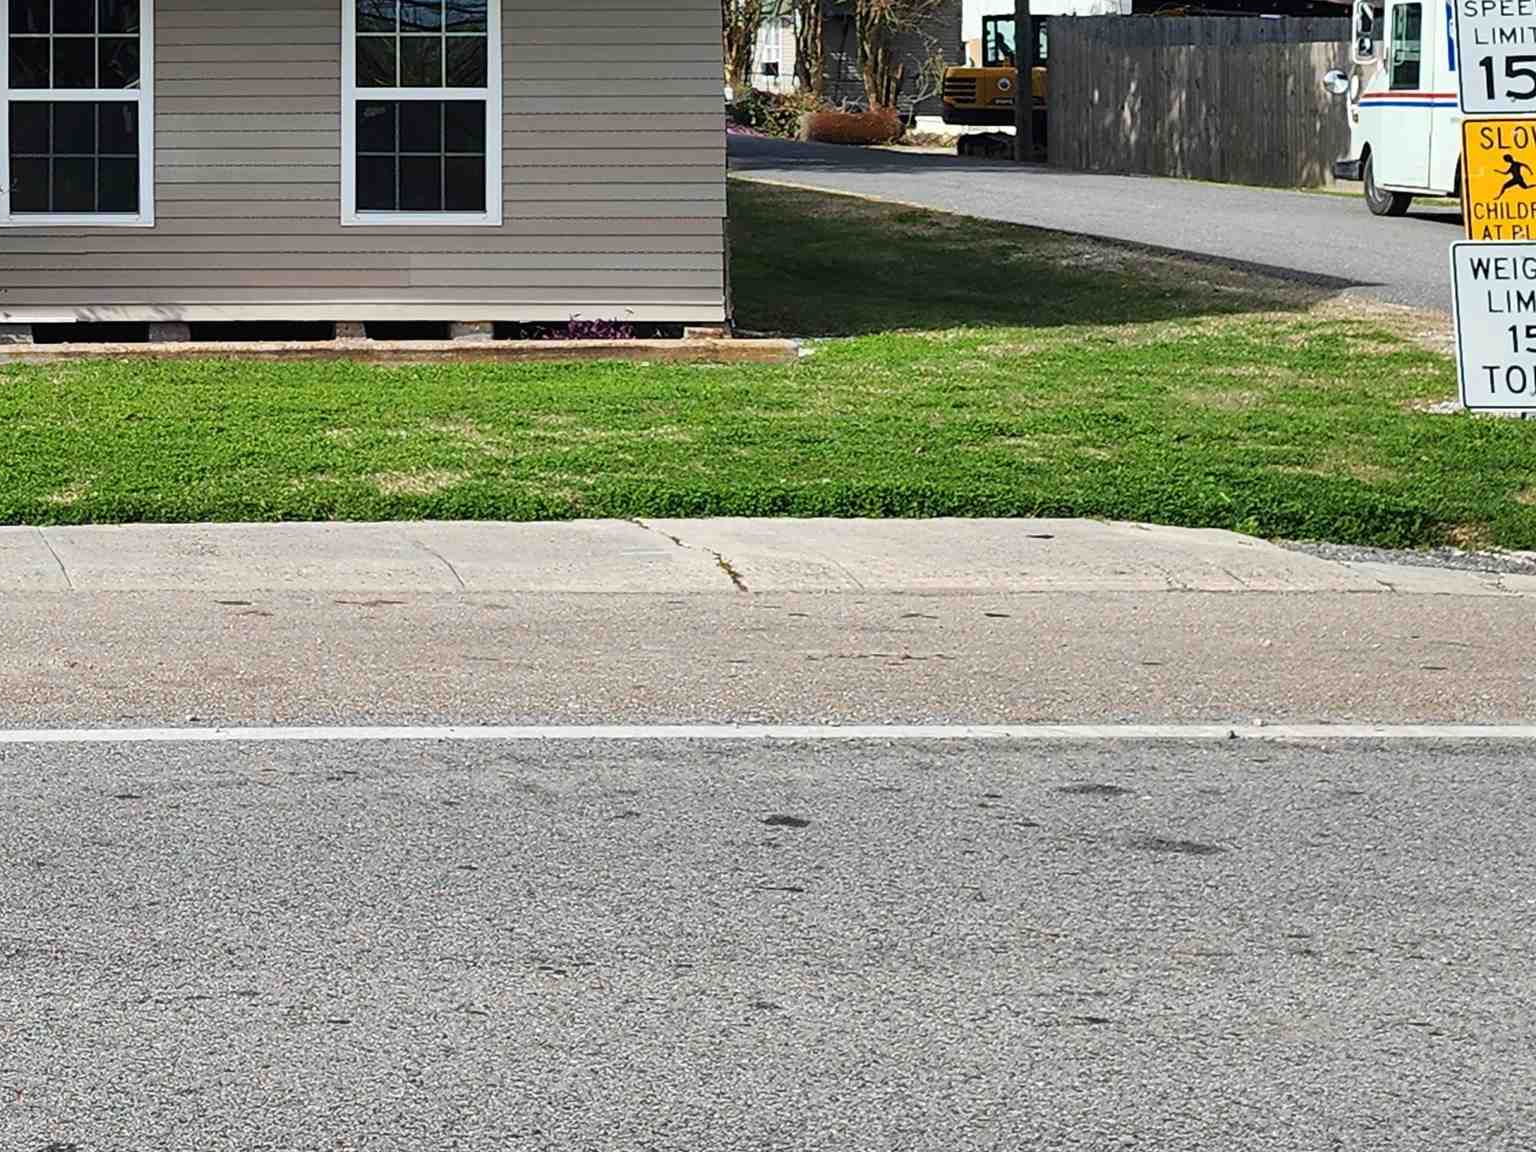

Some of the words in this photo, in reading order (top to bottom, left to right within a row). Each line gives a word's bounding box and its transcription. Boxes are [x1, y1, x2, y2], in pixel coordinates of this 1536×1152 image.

[1464, 0, 1536, 17] SPEE
[1475, 26, 1536, 45] LIMIT
[1480, 55, 1536, 100] 15
[1480, 126, 1536, 150] SLO
[1483, 224, 1503, 240] AT
[1470, 257, 1536, 280] WEIG
[1488, 290, 1536, 313] LIM
[1508, 325, 1536, 353] 15
[1482, 365, 1536, 394] TO
